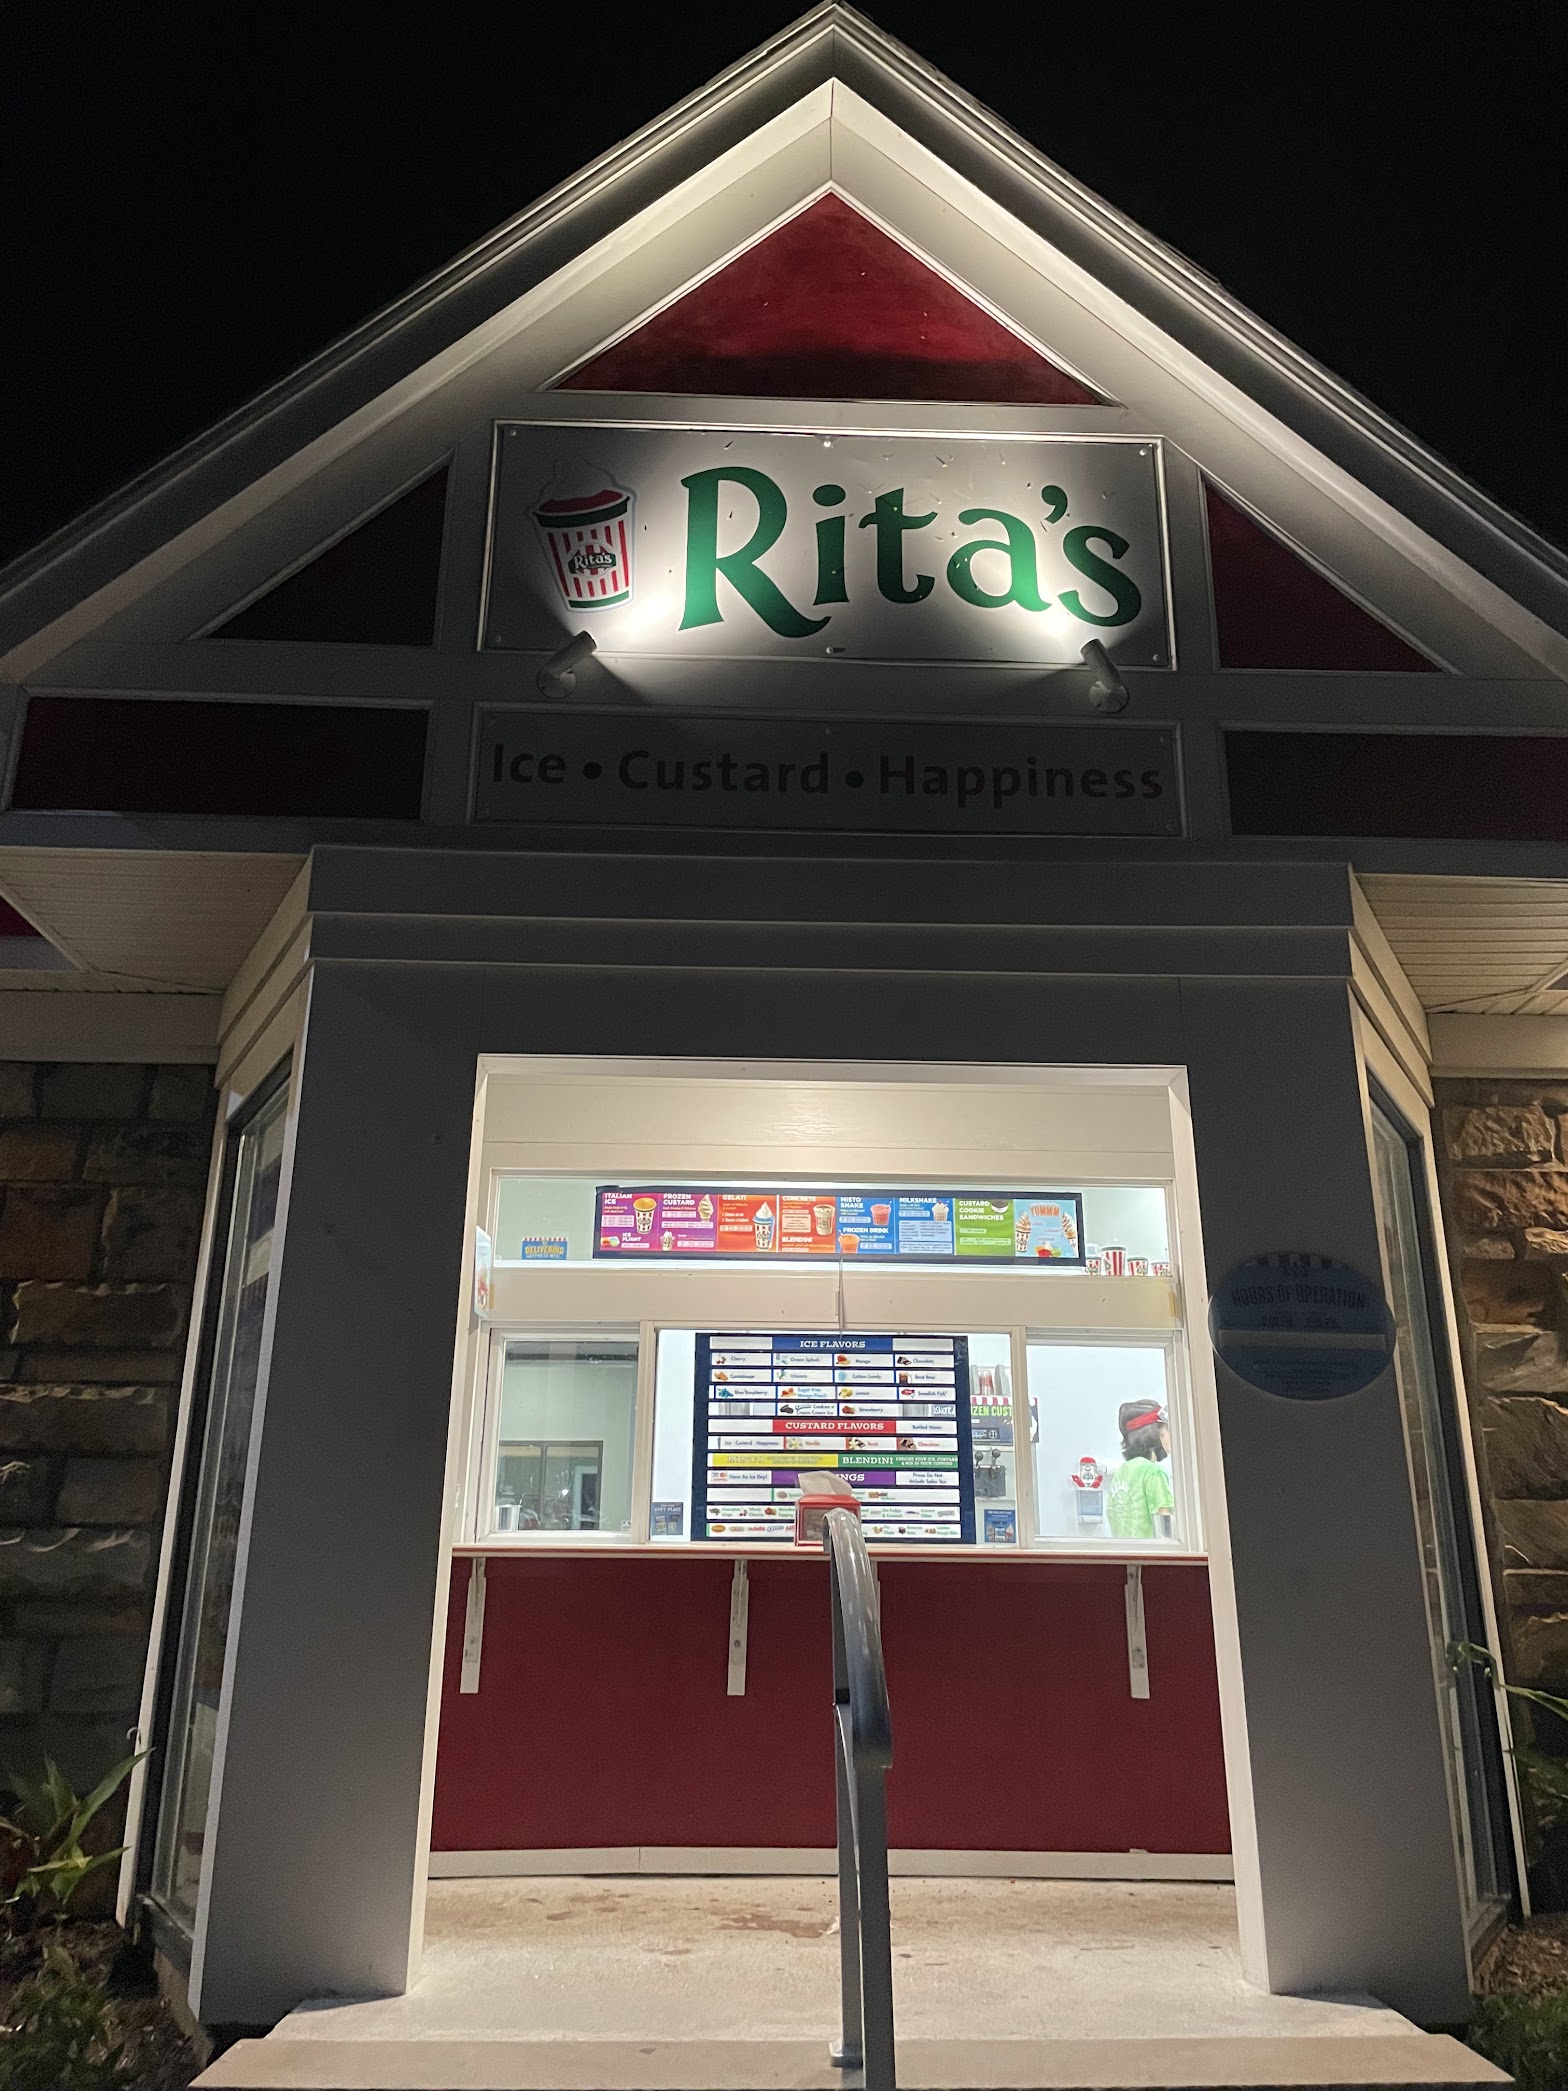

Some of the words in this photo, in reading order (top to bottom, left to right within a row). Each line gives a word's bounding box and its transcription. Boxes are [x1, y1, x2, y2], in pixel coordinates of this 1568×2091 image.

[573, 552, 612, 569] Rita's
[678, 466, 1142, 637] Rita's
[492, 743, 566, 784] Ice
[618, 750, 828, 794] Custard
[880, 756, 1162, 808] Happiness
[1230, 1285, 1273, 1308] HOURS
[1277, 1284, 1291, 1302] OF
[1295, 1283, 1367, 1311] OPERATION
[785, 1422, 835, 1430] CUSTARD
